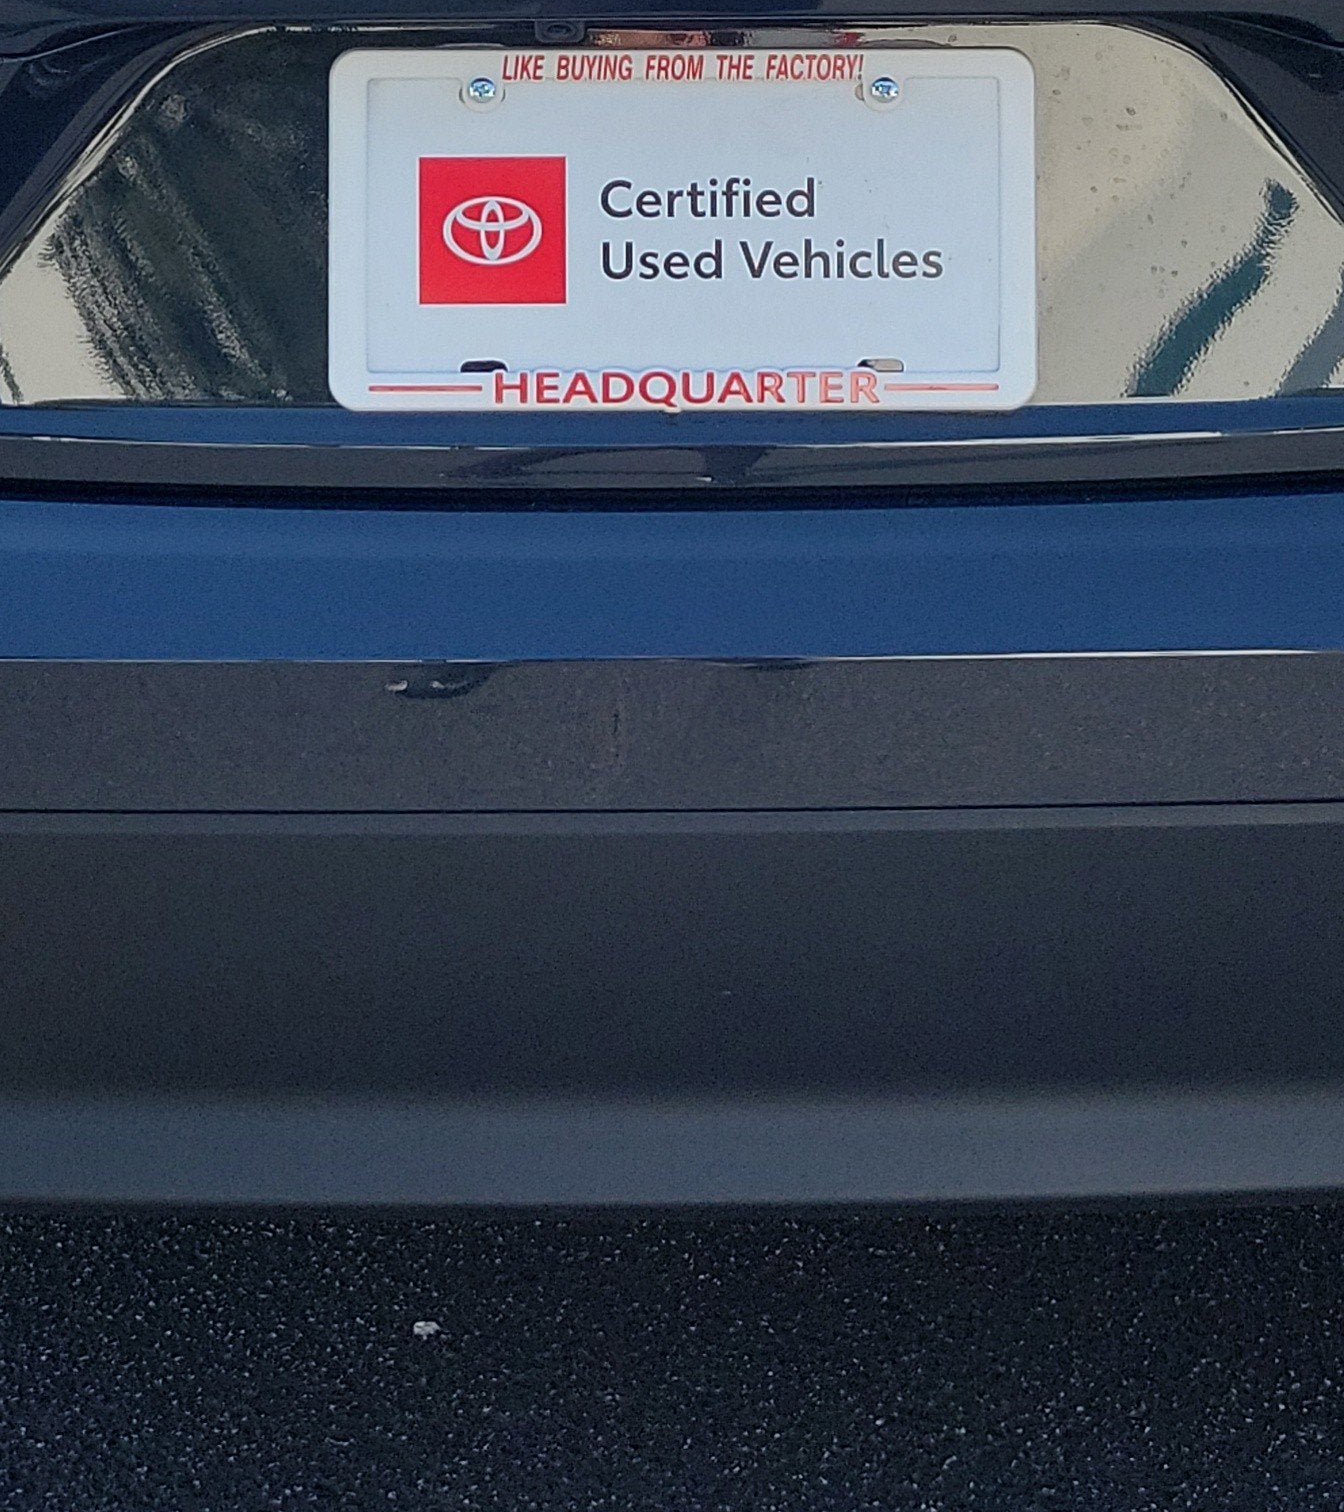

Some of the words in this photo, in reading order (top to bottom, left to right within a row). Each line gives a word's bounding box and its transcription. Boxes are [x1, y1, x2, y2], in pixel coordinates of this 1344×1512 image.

[502, 54, 545, 80] LIKE
[557, 54, 633, 81] BUYING
[645, 54, 704, 80] FROM
[716, 54, 755, 80] THE
[766, 54, 864, 80] FACTORY!
[600, 177, 817, 218] Certified
[601, 239, 722, 280] Used
[740, 239, 943, 280] Vehicles
[494, 371, 879, 407] HEADQUARTER
